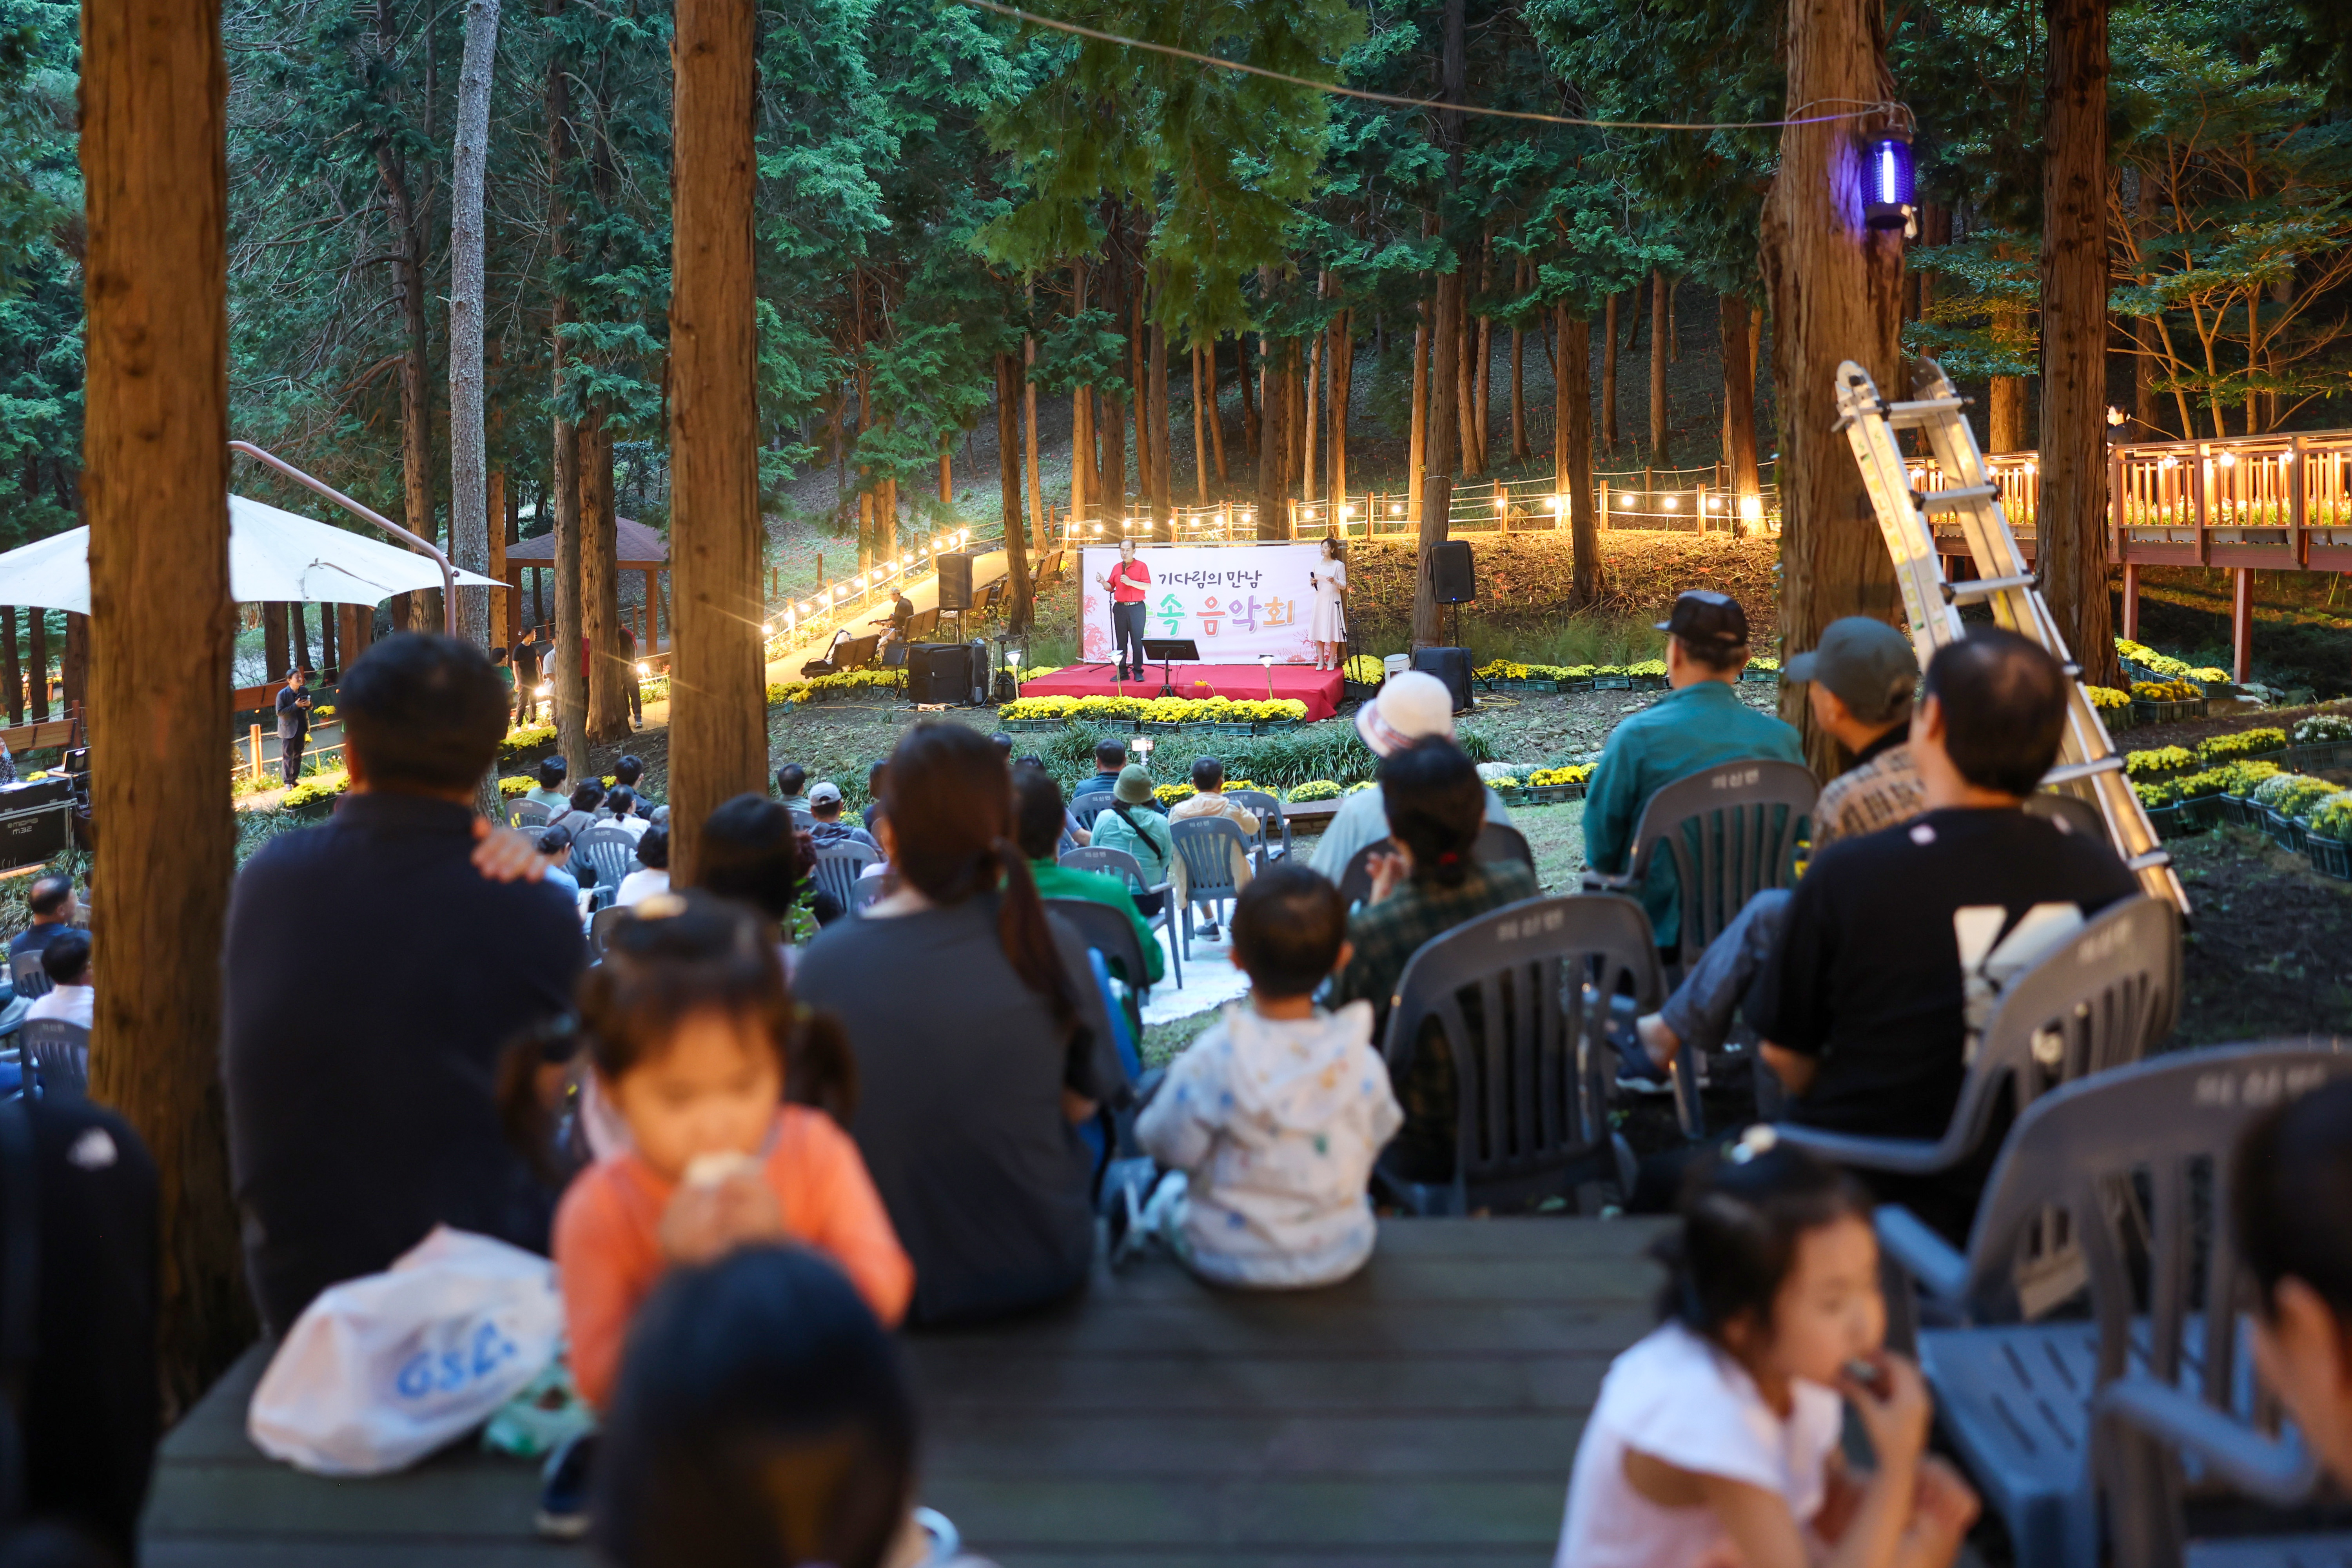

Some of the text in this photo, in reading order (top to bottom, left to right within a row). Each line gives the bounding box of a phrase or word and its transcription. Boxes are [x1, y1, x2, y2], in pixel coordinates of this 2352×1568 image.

[1158, 570, 1263, 589] 기다림의 만남
[1196, 595, 1293, 635] 음악회
